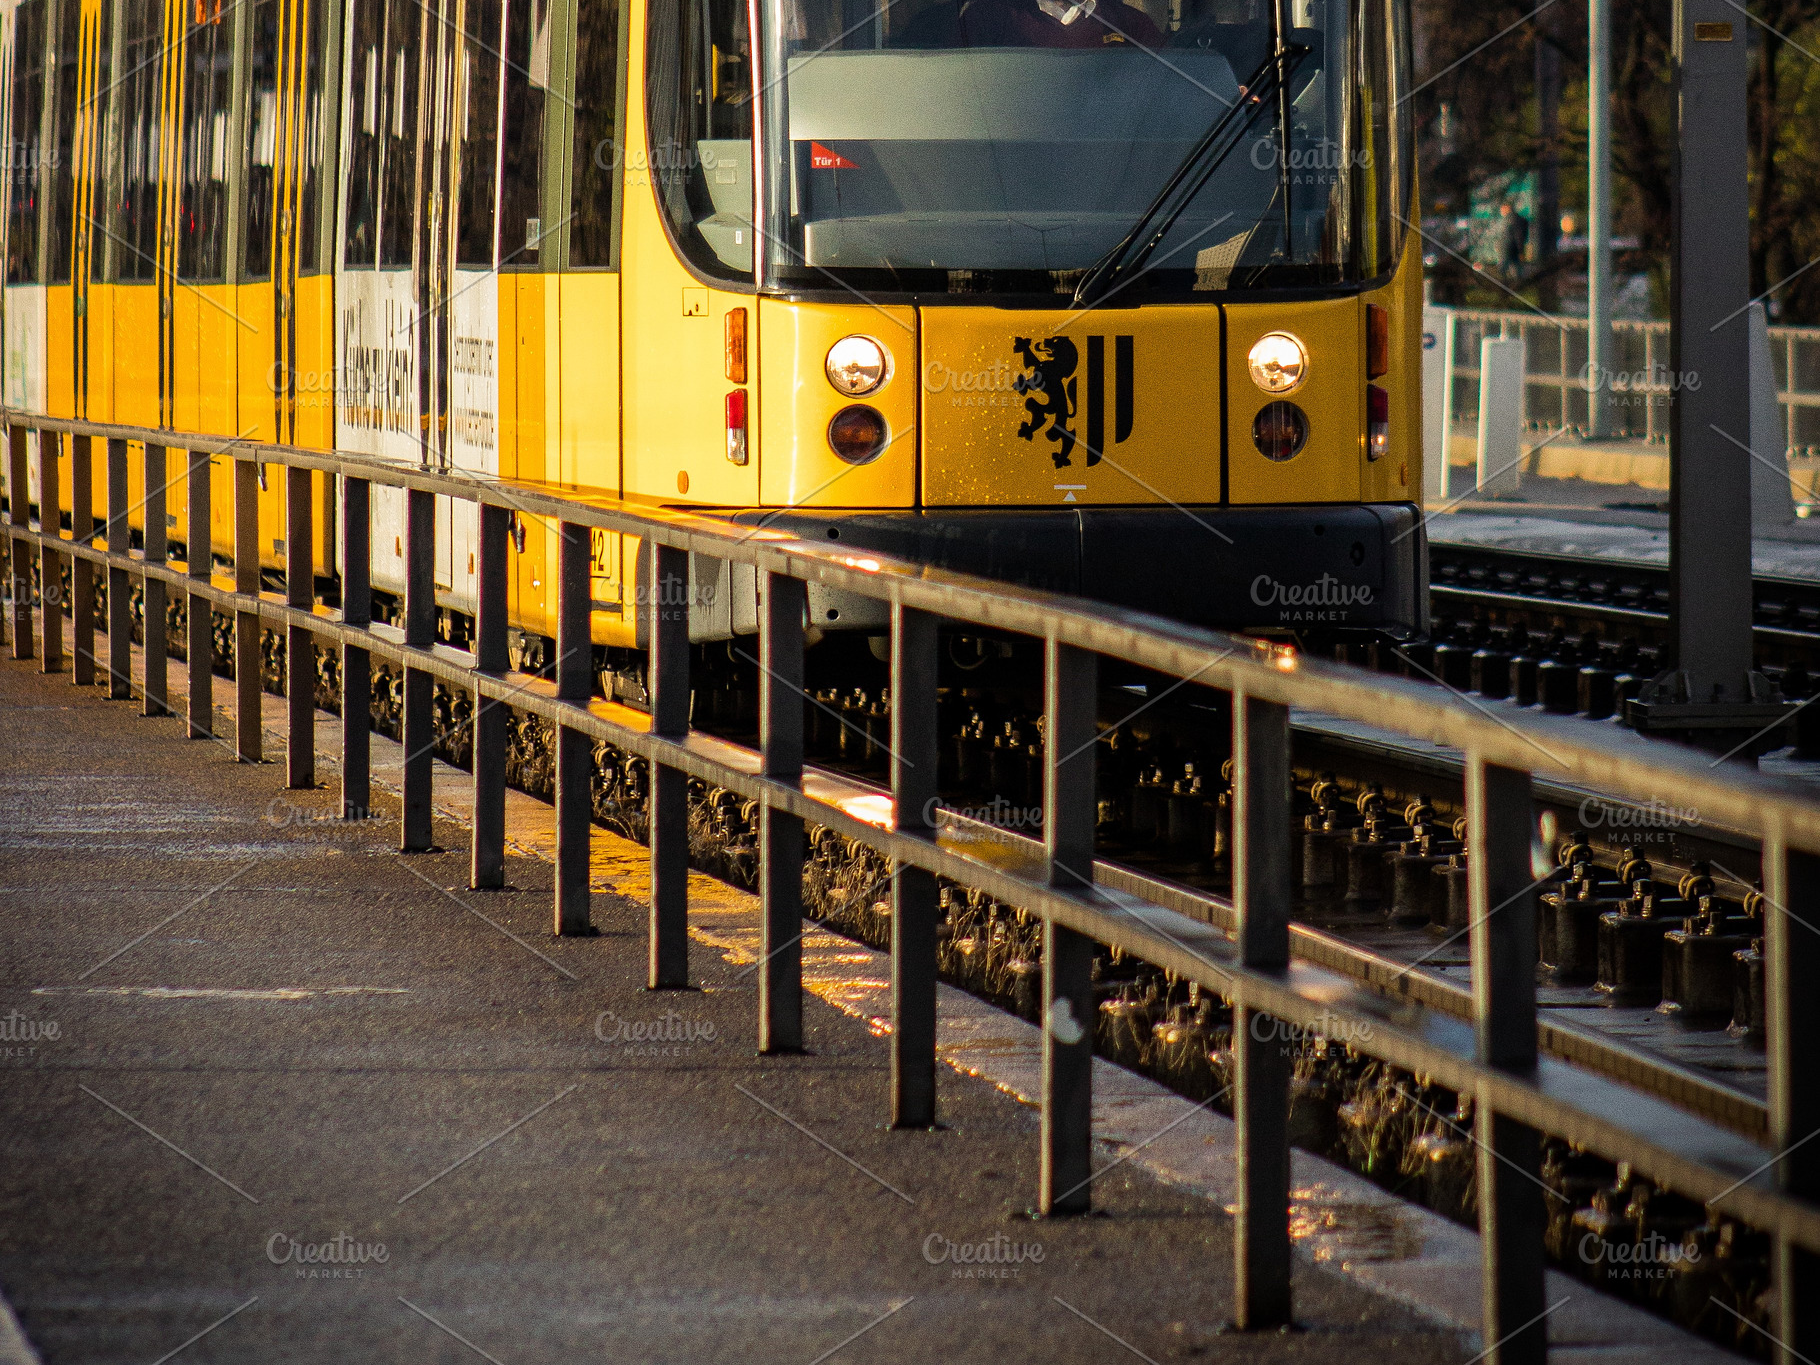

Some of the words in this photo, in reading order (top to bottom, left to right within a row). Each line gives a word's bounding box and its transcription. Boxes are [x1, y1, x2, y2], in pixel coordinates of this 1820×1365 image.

[814, 156, 832, 166] Tür
[835, 156, 841, 166] 1
[343, 298, 371, 430] Küche
[372, 347, 384, 434] zu
[385, 298, 414, 435] klein?
